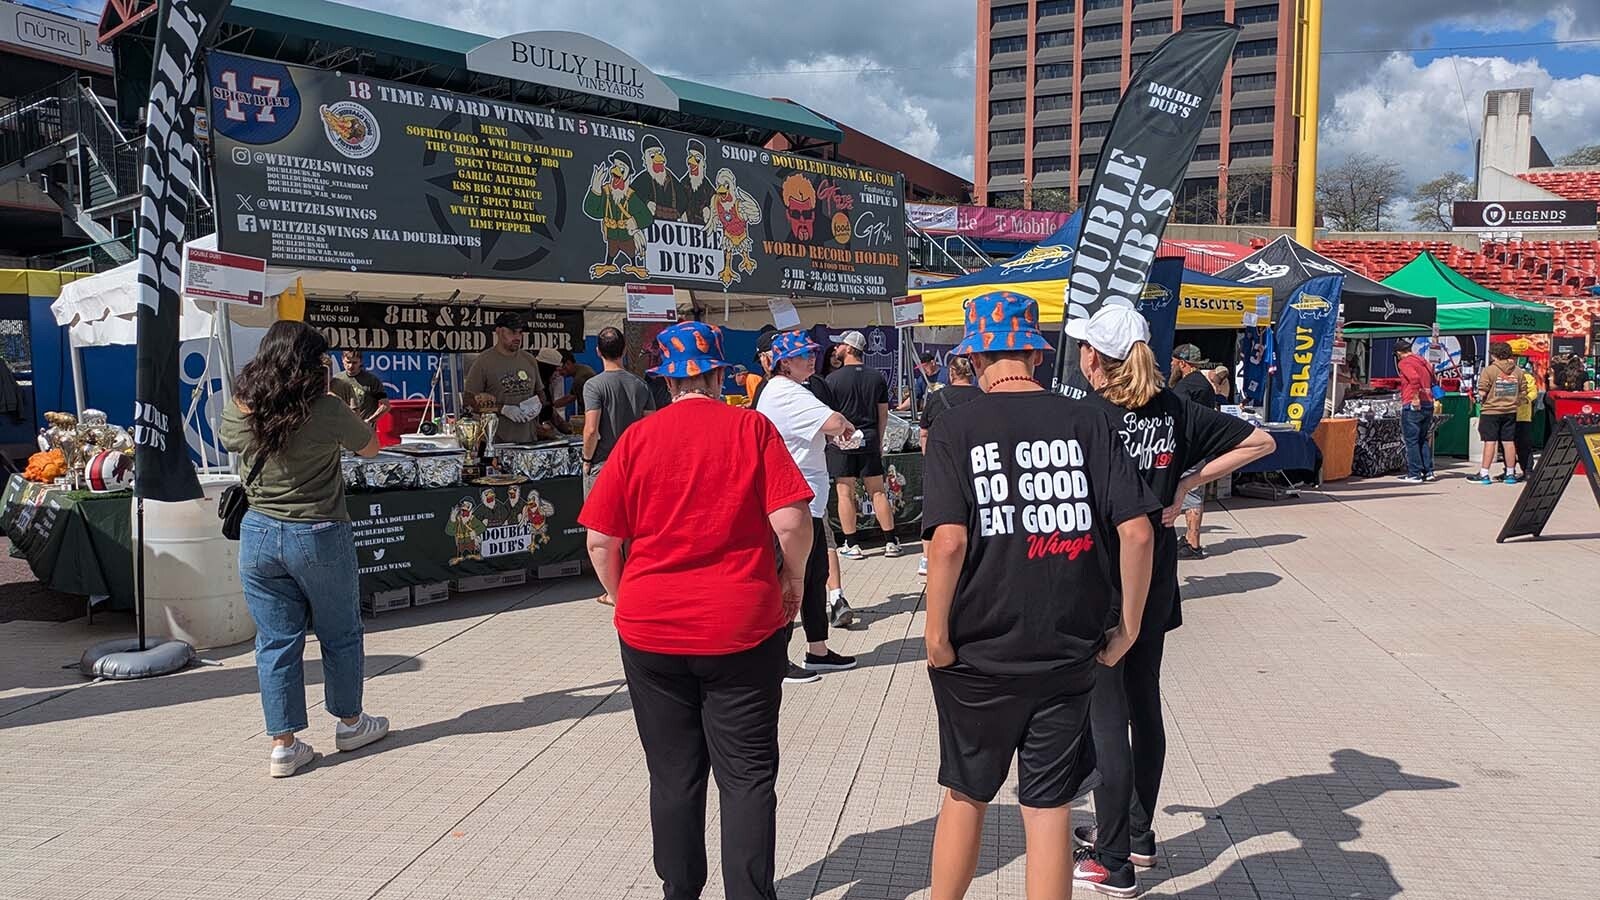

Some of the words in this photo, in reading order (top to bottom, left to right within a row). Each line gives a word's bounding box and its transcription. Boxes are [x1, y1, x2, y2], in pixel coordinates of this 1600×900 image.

[511, 40, 588, 76] BULLY
[594, 59, 645, 88] HILL
[213, 87, 252, 104] SPICY
[220, 70, 281, 123] 17
[576, 75, 645, 99] VINEYARDS
[1149, 81, 1202, 109] DOUBLE
[348, 80, 372, 100] 18
[378, 86, 424, 107] TIME
[429, 92, 490, 117] AWARD
[493, 105, 555, 129] WINNER
[558, 117, 575, 132] IN
[578, 121, 588, 135] 5
[591, 123, 636, 142] YEARS
[1149, 97, 1191, 119] DUB'S
[480, 124, 508, 136] MENU
[406, 125, 451, 140] SOFRITO
[453, 132, 479, 144] LOCO
[488, 137, 509, 148] WWI
[511, 140, 549, 154] BUFFALO
[550, 148, 573, 158] MILD
[253, 152, 374, 177] @WEITZELSWINGS
[425, 141, 447, 152] THE
[449, 144, 490, 158] CREAMY
[492, 149, 522, 162] PEACH
[541, 157, 560, 169] BBQ
[721, 144, 757, 163] SHOP
[759, 152, 770, 164] @
[772, 153, 894, 187] DOUBLEDUBSSWAG.COM
[454, 156, 484, 169] SPICY
[486, 160, 538, 177] VEGETABLE
[458, 168, 493, 182] GARLIC
[495, 175, 536, 188] ALFREDO
[452, 180, 471, 192] KSS
[473, 183, 491, 194] BIG
[493, 185, 513, 197] MAC
[514, 188, 543, 200] SAUCE
[859, 192, 891, 207] TRIPLE
[892, 198, 898, 207] D
[256, 198, 377, 220] @WEITZELSWINGS
[463, 195, 480, 205] #17
[482, 196, 510, 209] SPICY
[512, 199, 535, 211] BLEU
[450, 204, 479, 217] WWIV
[480, 207, 522, 221] BUFFALO
[523, 211, 547, 224] XHOT
[1508, 209, 1567, 220] LEGENDS
[259, 219, 369, 239] WEITZELSWINGS
[372, 229, 399, 241] AKA
[402, 231, 481, 247] DOUBLEDUBS
[470, 218, 493, 230] LIME
[495, 221, 532, 234] PEPPER
[1011, 215, 1057, 236] Mobile
[647, 223, 724, 250] DOUBLE
[659, 250, 715, 276] DUB'S
[763, 240, 806, 258] WORLD
[809, 245, 852, 262] RECORD
[855, 250, 899, 267] HOLDER
[781, 279, 791, 289] 24
[793, 280, 806, 290] HR
[840, 284, 865, 294] WINGS
[866, 285, 887, 295] SOLD
[784, 268, 790, 278] 8
[792, 269, 805, 280] HR
[810, 270, 836, 283] 28,043
[837, 273, 862, 284] WINGS
[864, 275, 884, 285] SOLD
[320, 304, 350, 312] 28,043
[1184, 297, 1244, 311] BISCUITS
[309, 314, 337, 323] WINGS
[338, 315, 360, 323] SOLD
[384, 305, 429, 325] 8HR
[436, 306, 455, 327] &
[549, 321, 564, 329] SOLD
[313, 326, 390, 349] ORLD
[396, 328, 487, 350] RECORD
[492, 331, 573, 351] LDER
[366, 354, 421, 371] JOHN
[1123, 411, 1162, 433] Born
[1164, 411, 1174, 426] in
[971, 442, 1001, 474] BE
[1015, 439, 1084, 469] GOOD
[974, 473, 1008, 505] DO
[1018, 470, 1089, 501] GOOD
[352, 519, 374, 527] WINGS
[375, 518, 389, 526] AKA
[390, 514, 416, 523] DOUBLE
[417, 512, 435, 520] DUBS
[979, 505, 1015, 537] EAT
[1022, 502, 1092, 533] GOOD
[354, 535, 406, 547] OUBLEDUBS.SW
[482, 523, 531, 542] DOUBLE
[489, 539, 525, 555] DUB'S
[1026, 530, 1094, 561] Wings
[389, 562, 412, 570] WINGS
